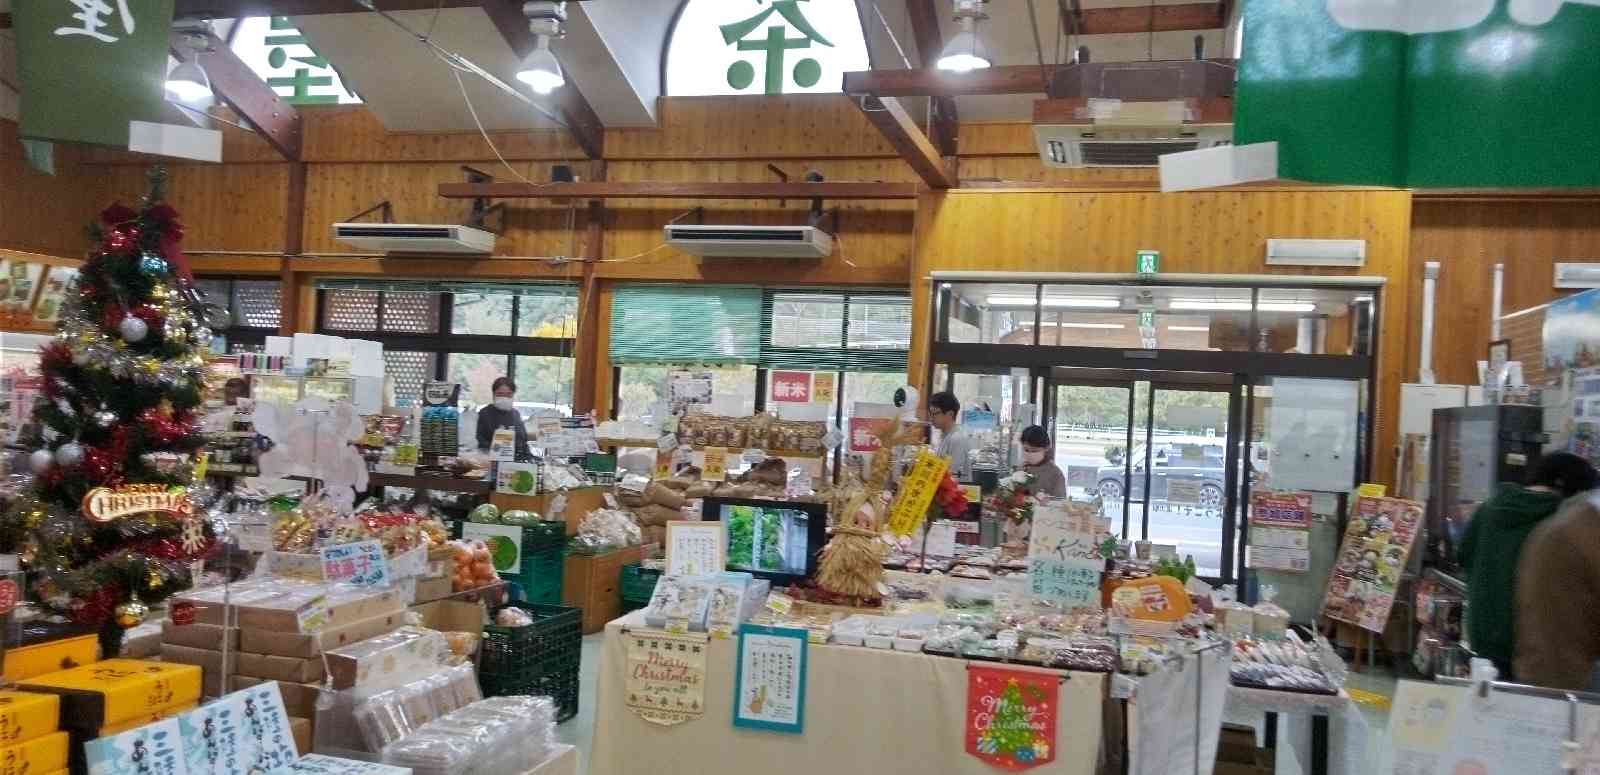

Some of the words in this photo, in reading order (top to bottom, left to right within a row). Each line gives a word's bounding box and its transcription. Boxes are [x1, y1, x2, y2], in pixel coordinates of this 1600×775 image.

[632, 663, 700, 684] Christmas
[647, 653, 688, 671] Merry
[980, 695, 1050, 724] Merry
[974, 711, 1047, 736] Christmas
